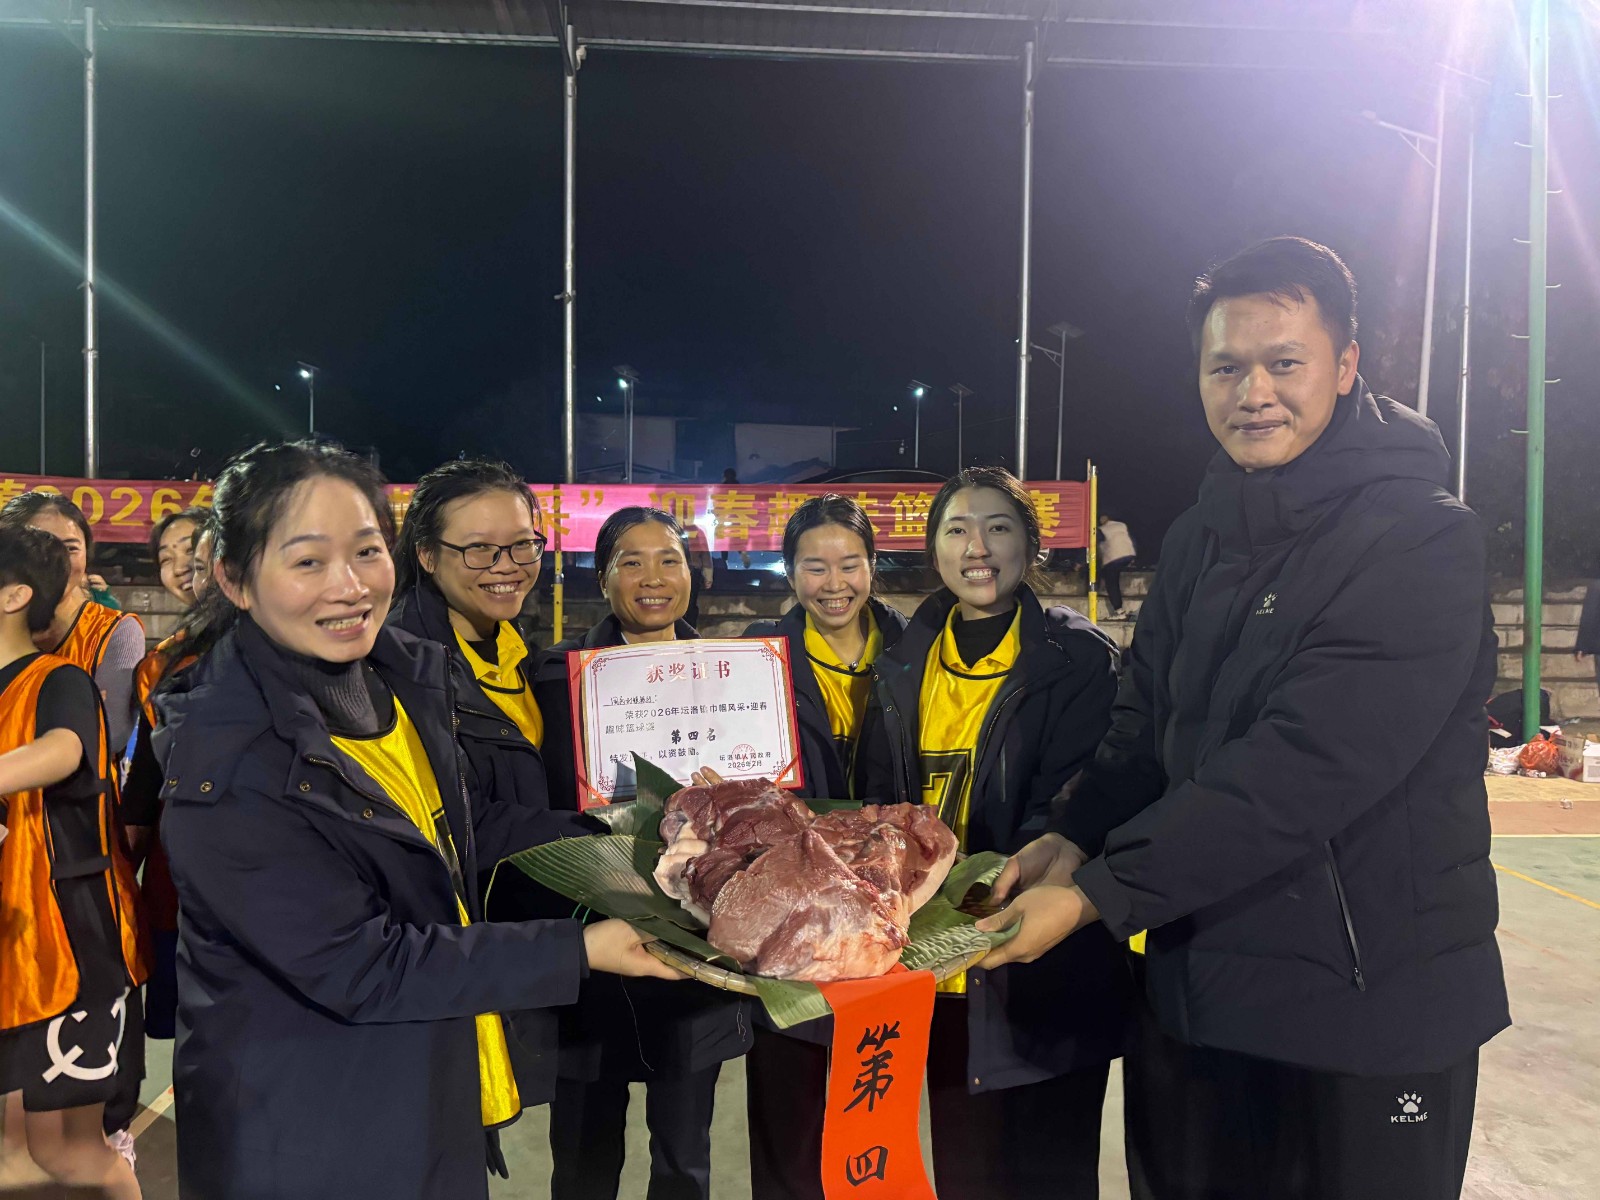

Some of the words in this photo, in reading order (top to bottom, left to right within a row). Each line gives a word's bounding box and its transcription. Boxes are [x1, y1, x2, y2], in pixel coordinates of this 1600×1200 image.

[646, 660, 731, 684] 获奖证书
[671, 728, 717, 745] 第四名
[843, 1020, 901, 1187] 第四
